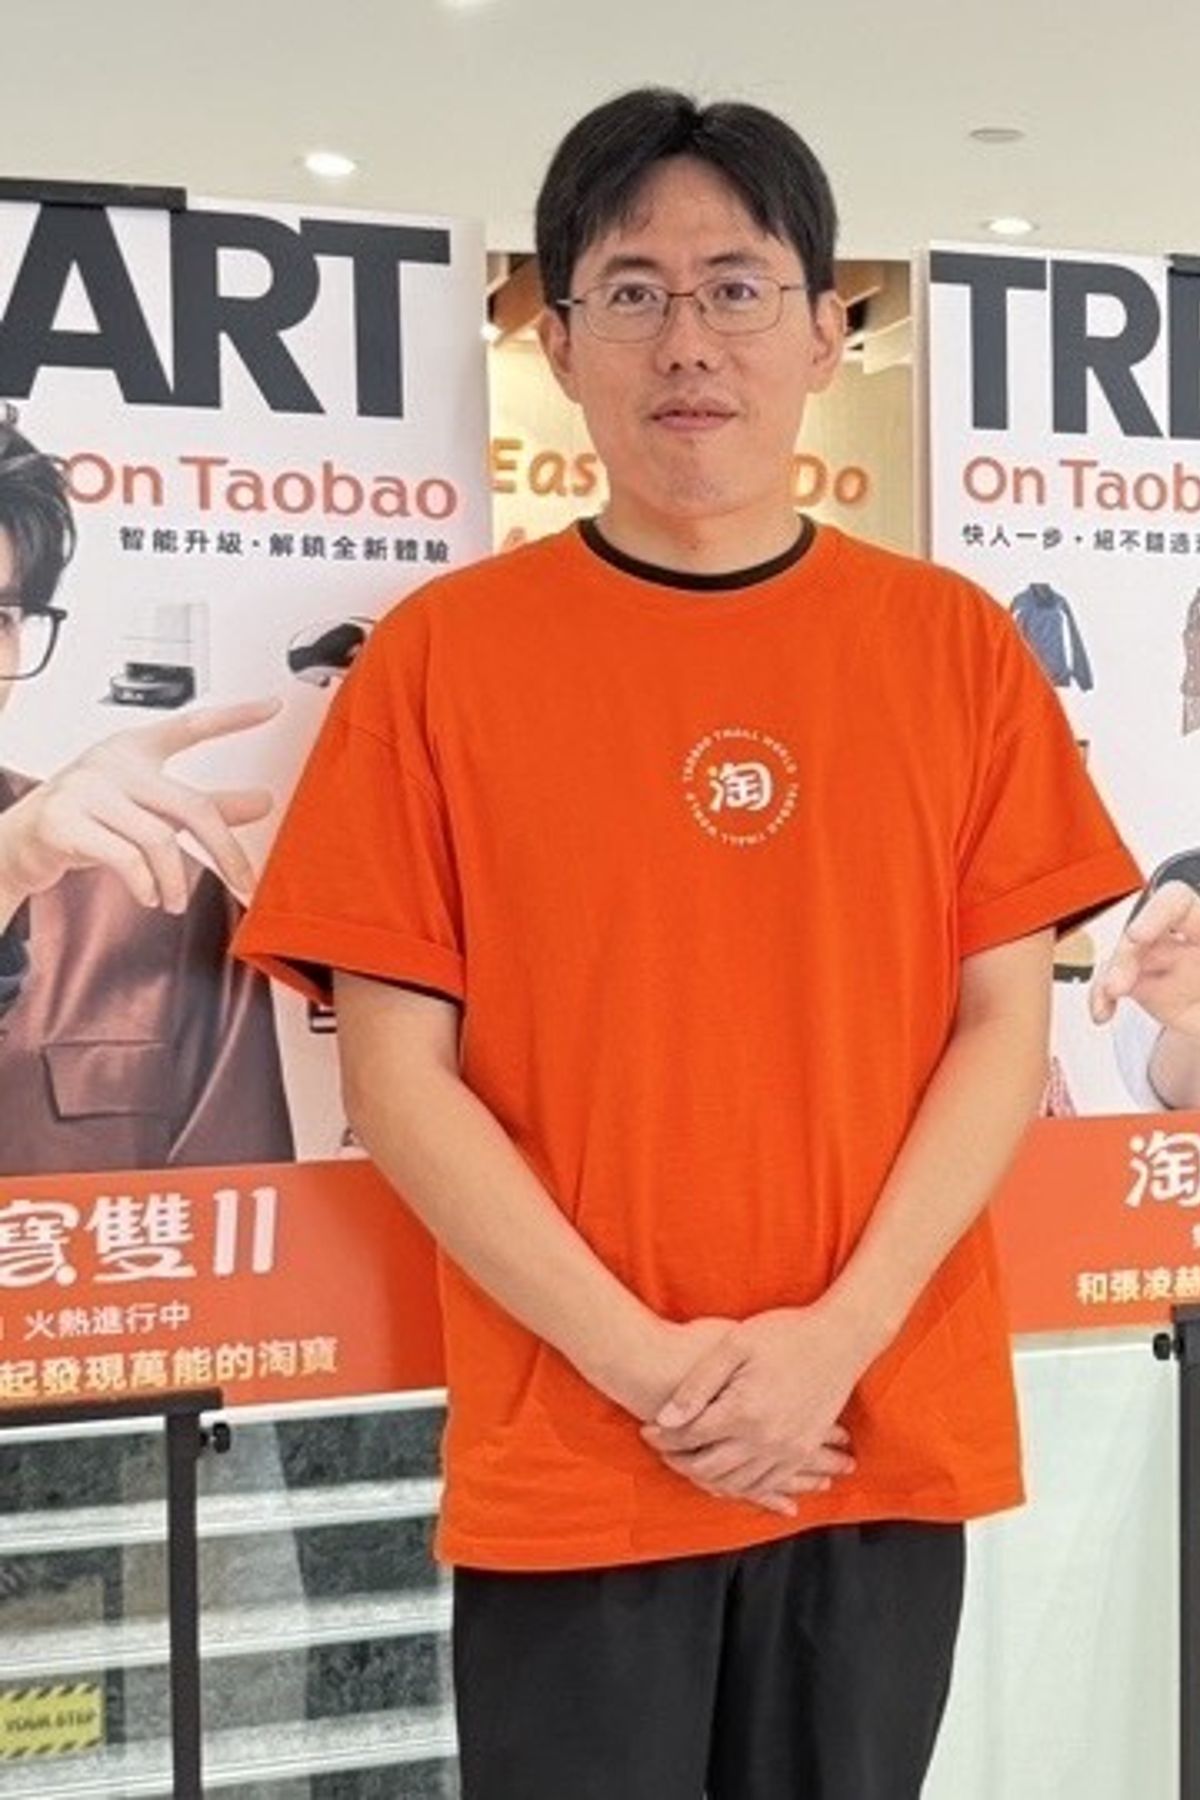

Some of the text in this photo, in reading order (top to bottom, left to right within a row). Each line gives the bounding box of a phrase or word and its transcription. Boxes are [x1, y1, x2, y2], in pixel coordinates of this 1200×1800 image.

[65, 451, 459, 521] On Taobao
[487, 437, 597, 498] Eas
[962, 456, 1046, 506] On
[707, 761, 772, 813] 淘
[24, 1300, 191, 1342] 火熱進行中
